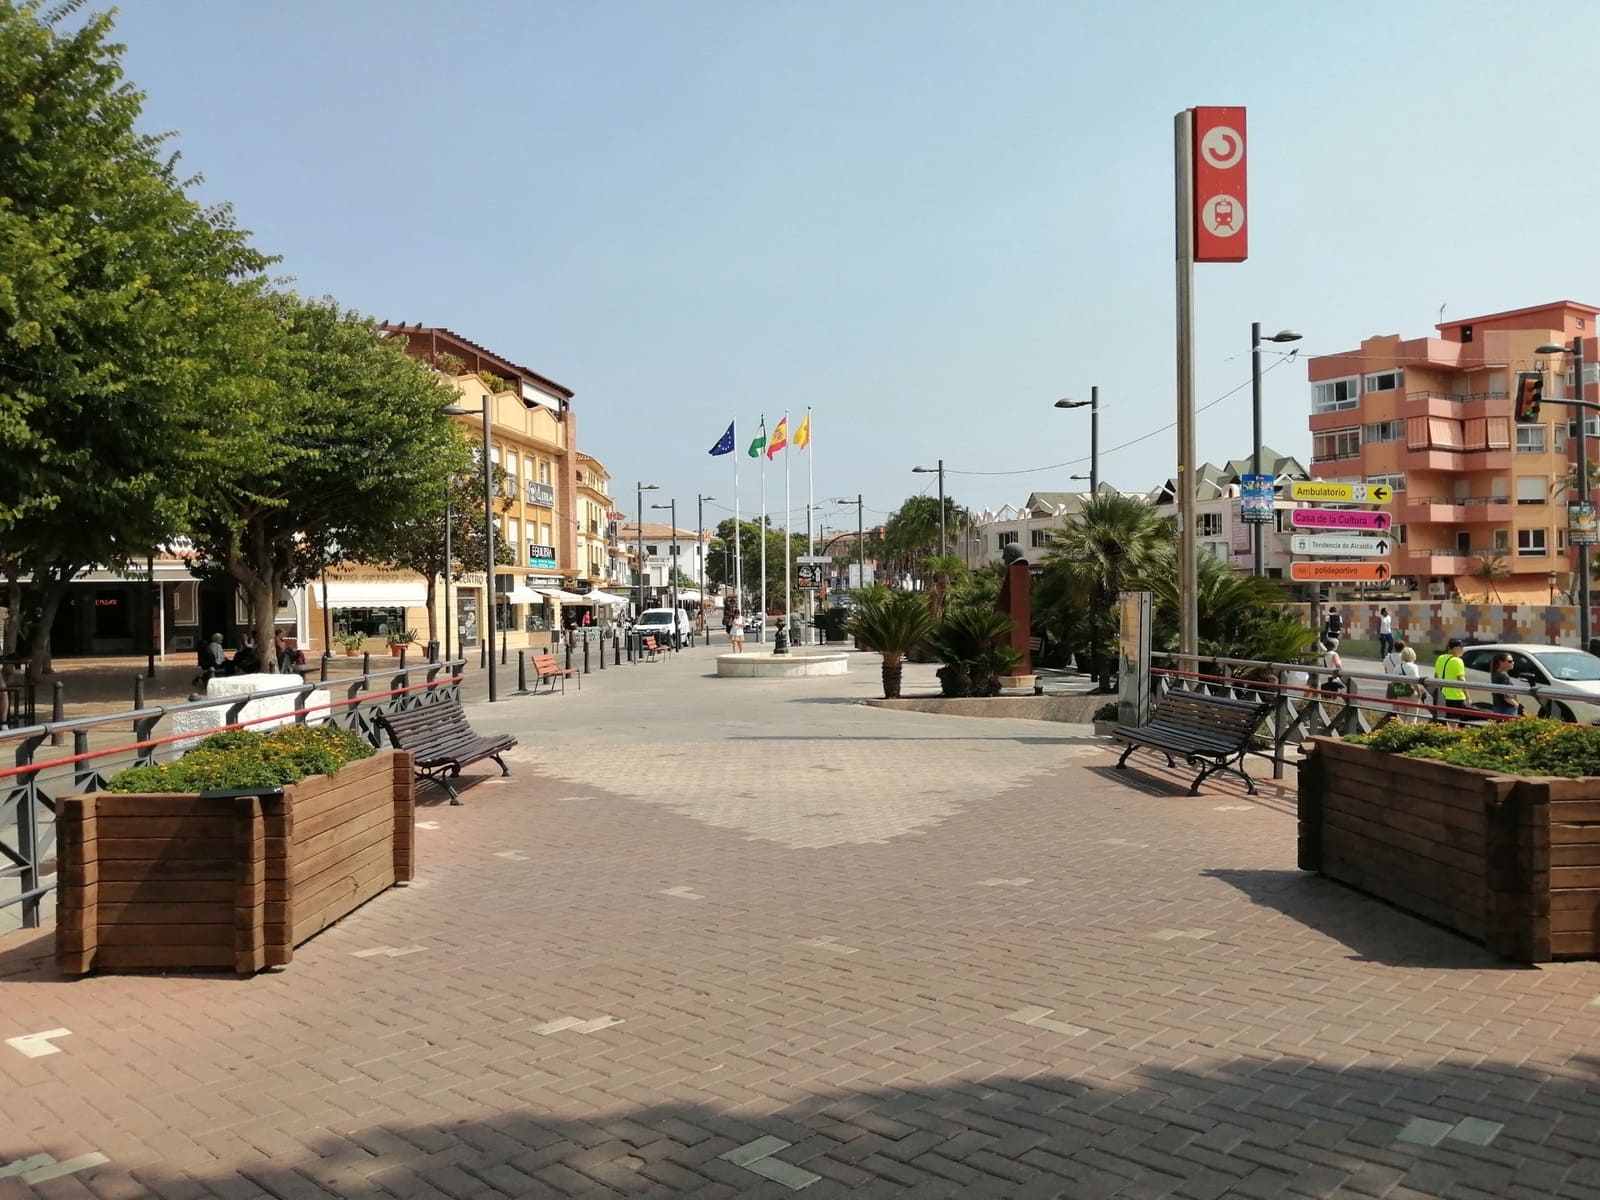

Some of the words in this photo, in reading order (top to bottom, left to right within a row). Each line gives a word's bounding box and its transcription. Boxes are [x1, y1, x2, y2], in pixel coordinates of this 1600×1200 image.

[1296, 487, 1346, 497] Ambulatorio
[1295, 513, 1315, 523] Casa
[1317, 514, 1328, 523] de
[1329, 515, 1336, 524] la
[1338, 515, 1367, 525] Cultura
[1314, 566, 1358, 575] polideportivo
